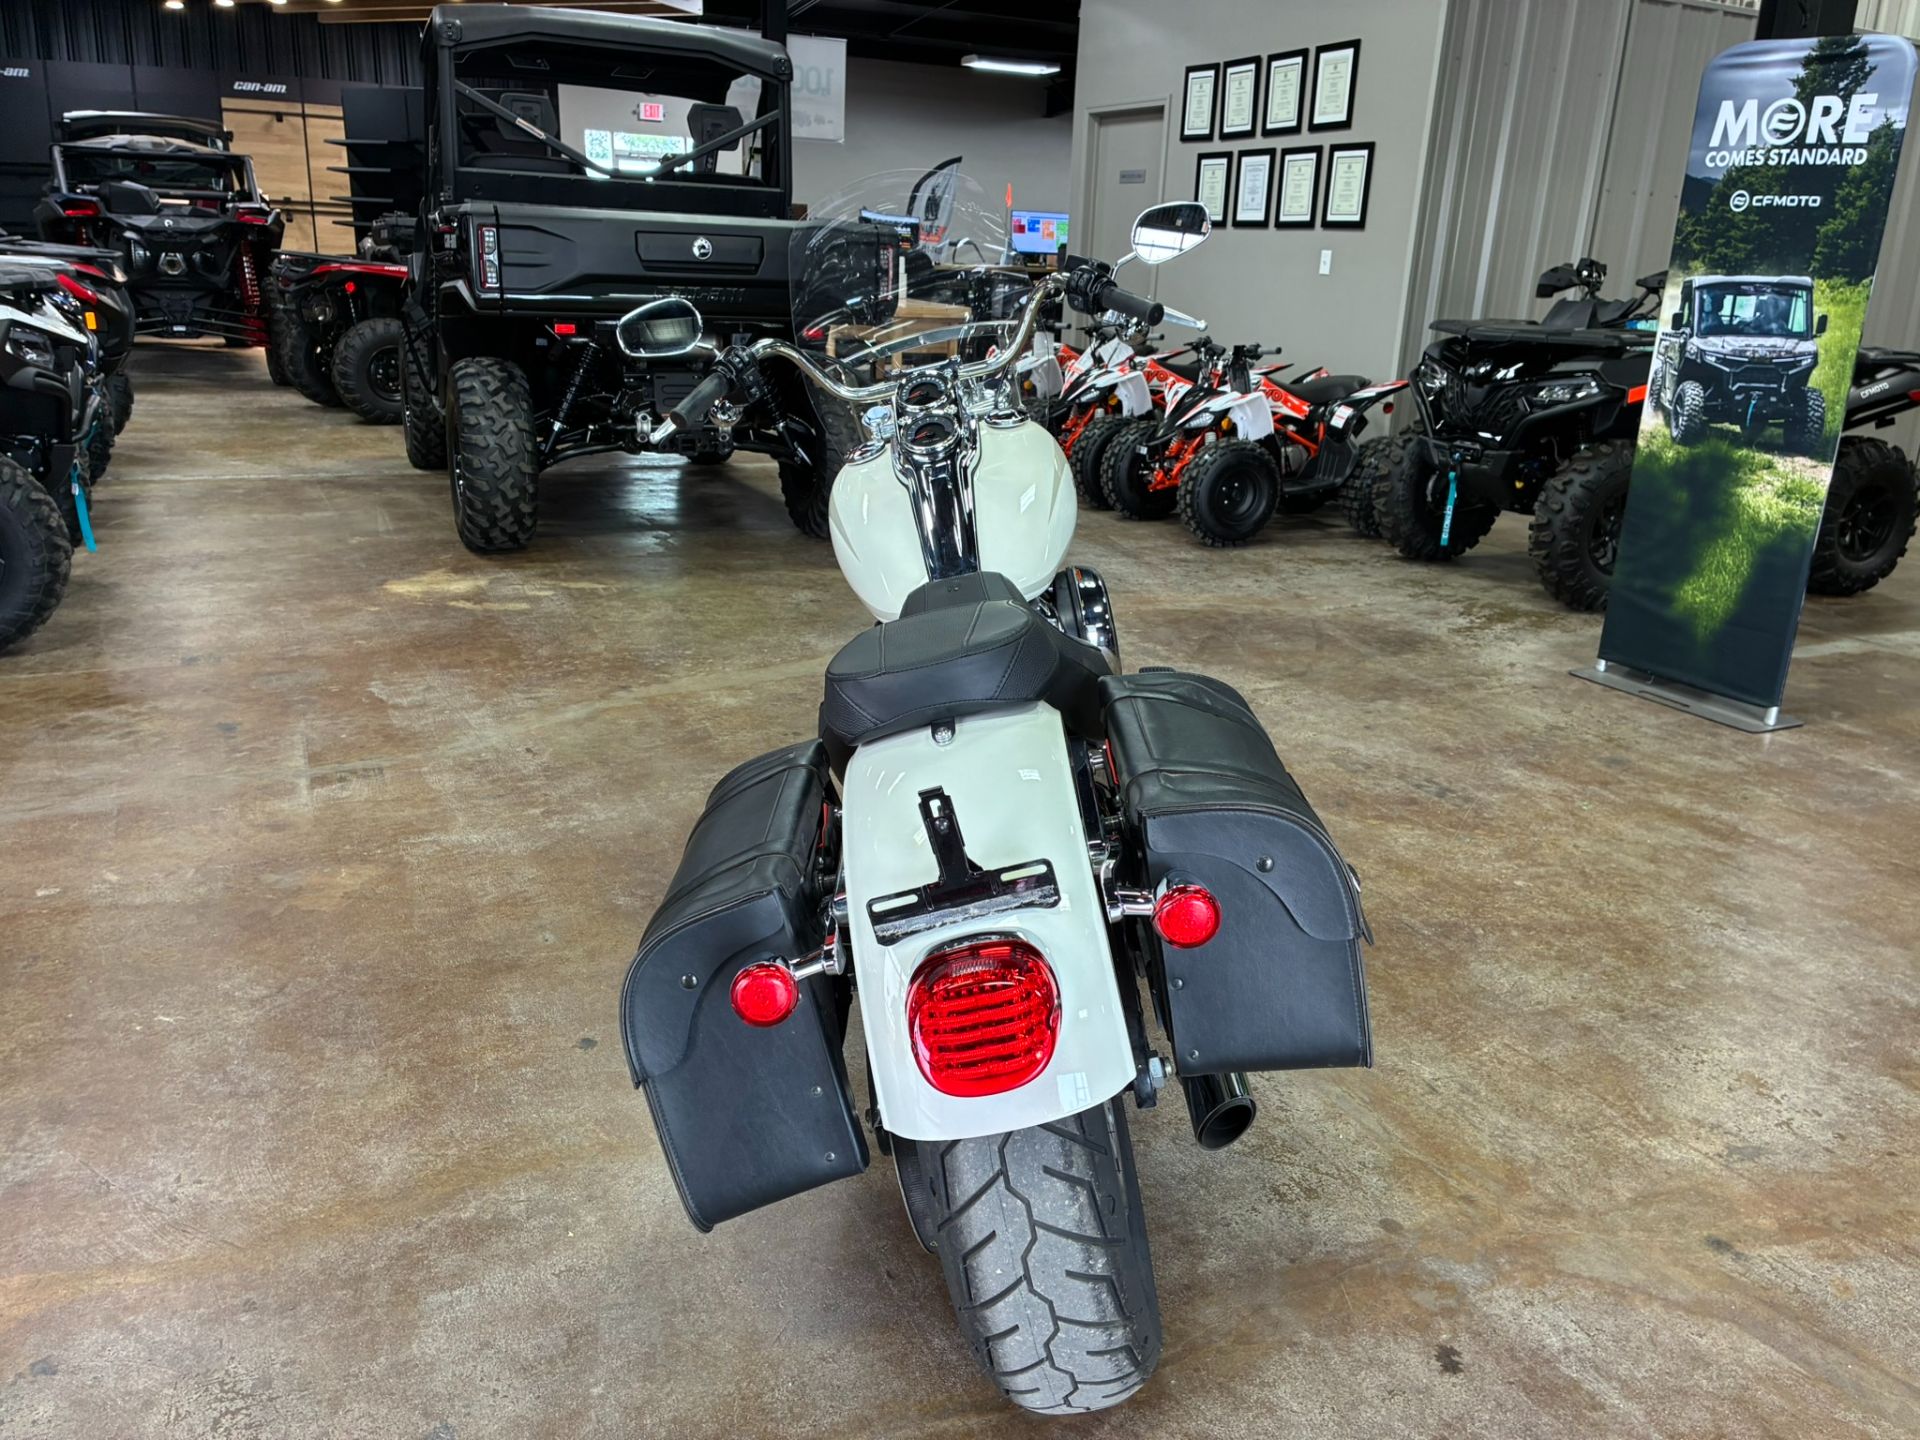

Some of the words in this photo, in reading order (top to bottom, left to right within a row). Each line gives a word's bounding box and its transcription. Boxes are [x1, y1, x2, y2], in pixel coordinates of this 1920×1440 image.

[233, 81, 287, 94] can-am
[643, 103, 660, 119] EXIT
[1708, 93, 1879, 147] MORE
[1704, 149, 1766, 168] COMES
[1767, 147, 1869, 167] STANDARD
[1751, 195, 1822, 208] CFMOTO
[1860, 382, 1890, 399] CFMOTO
